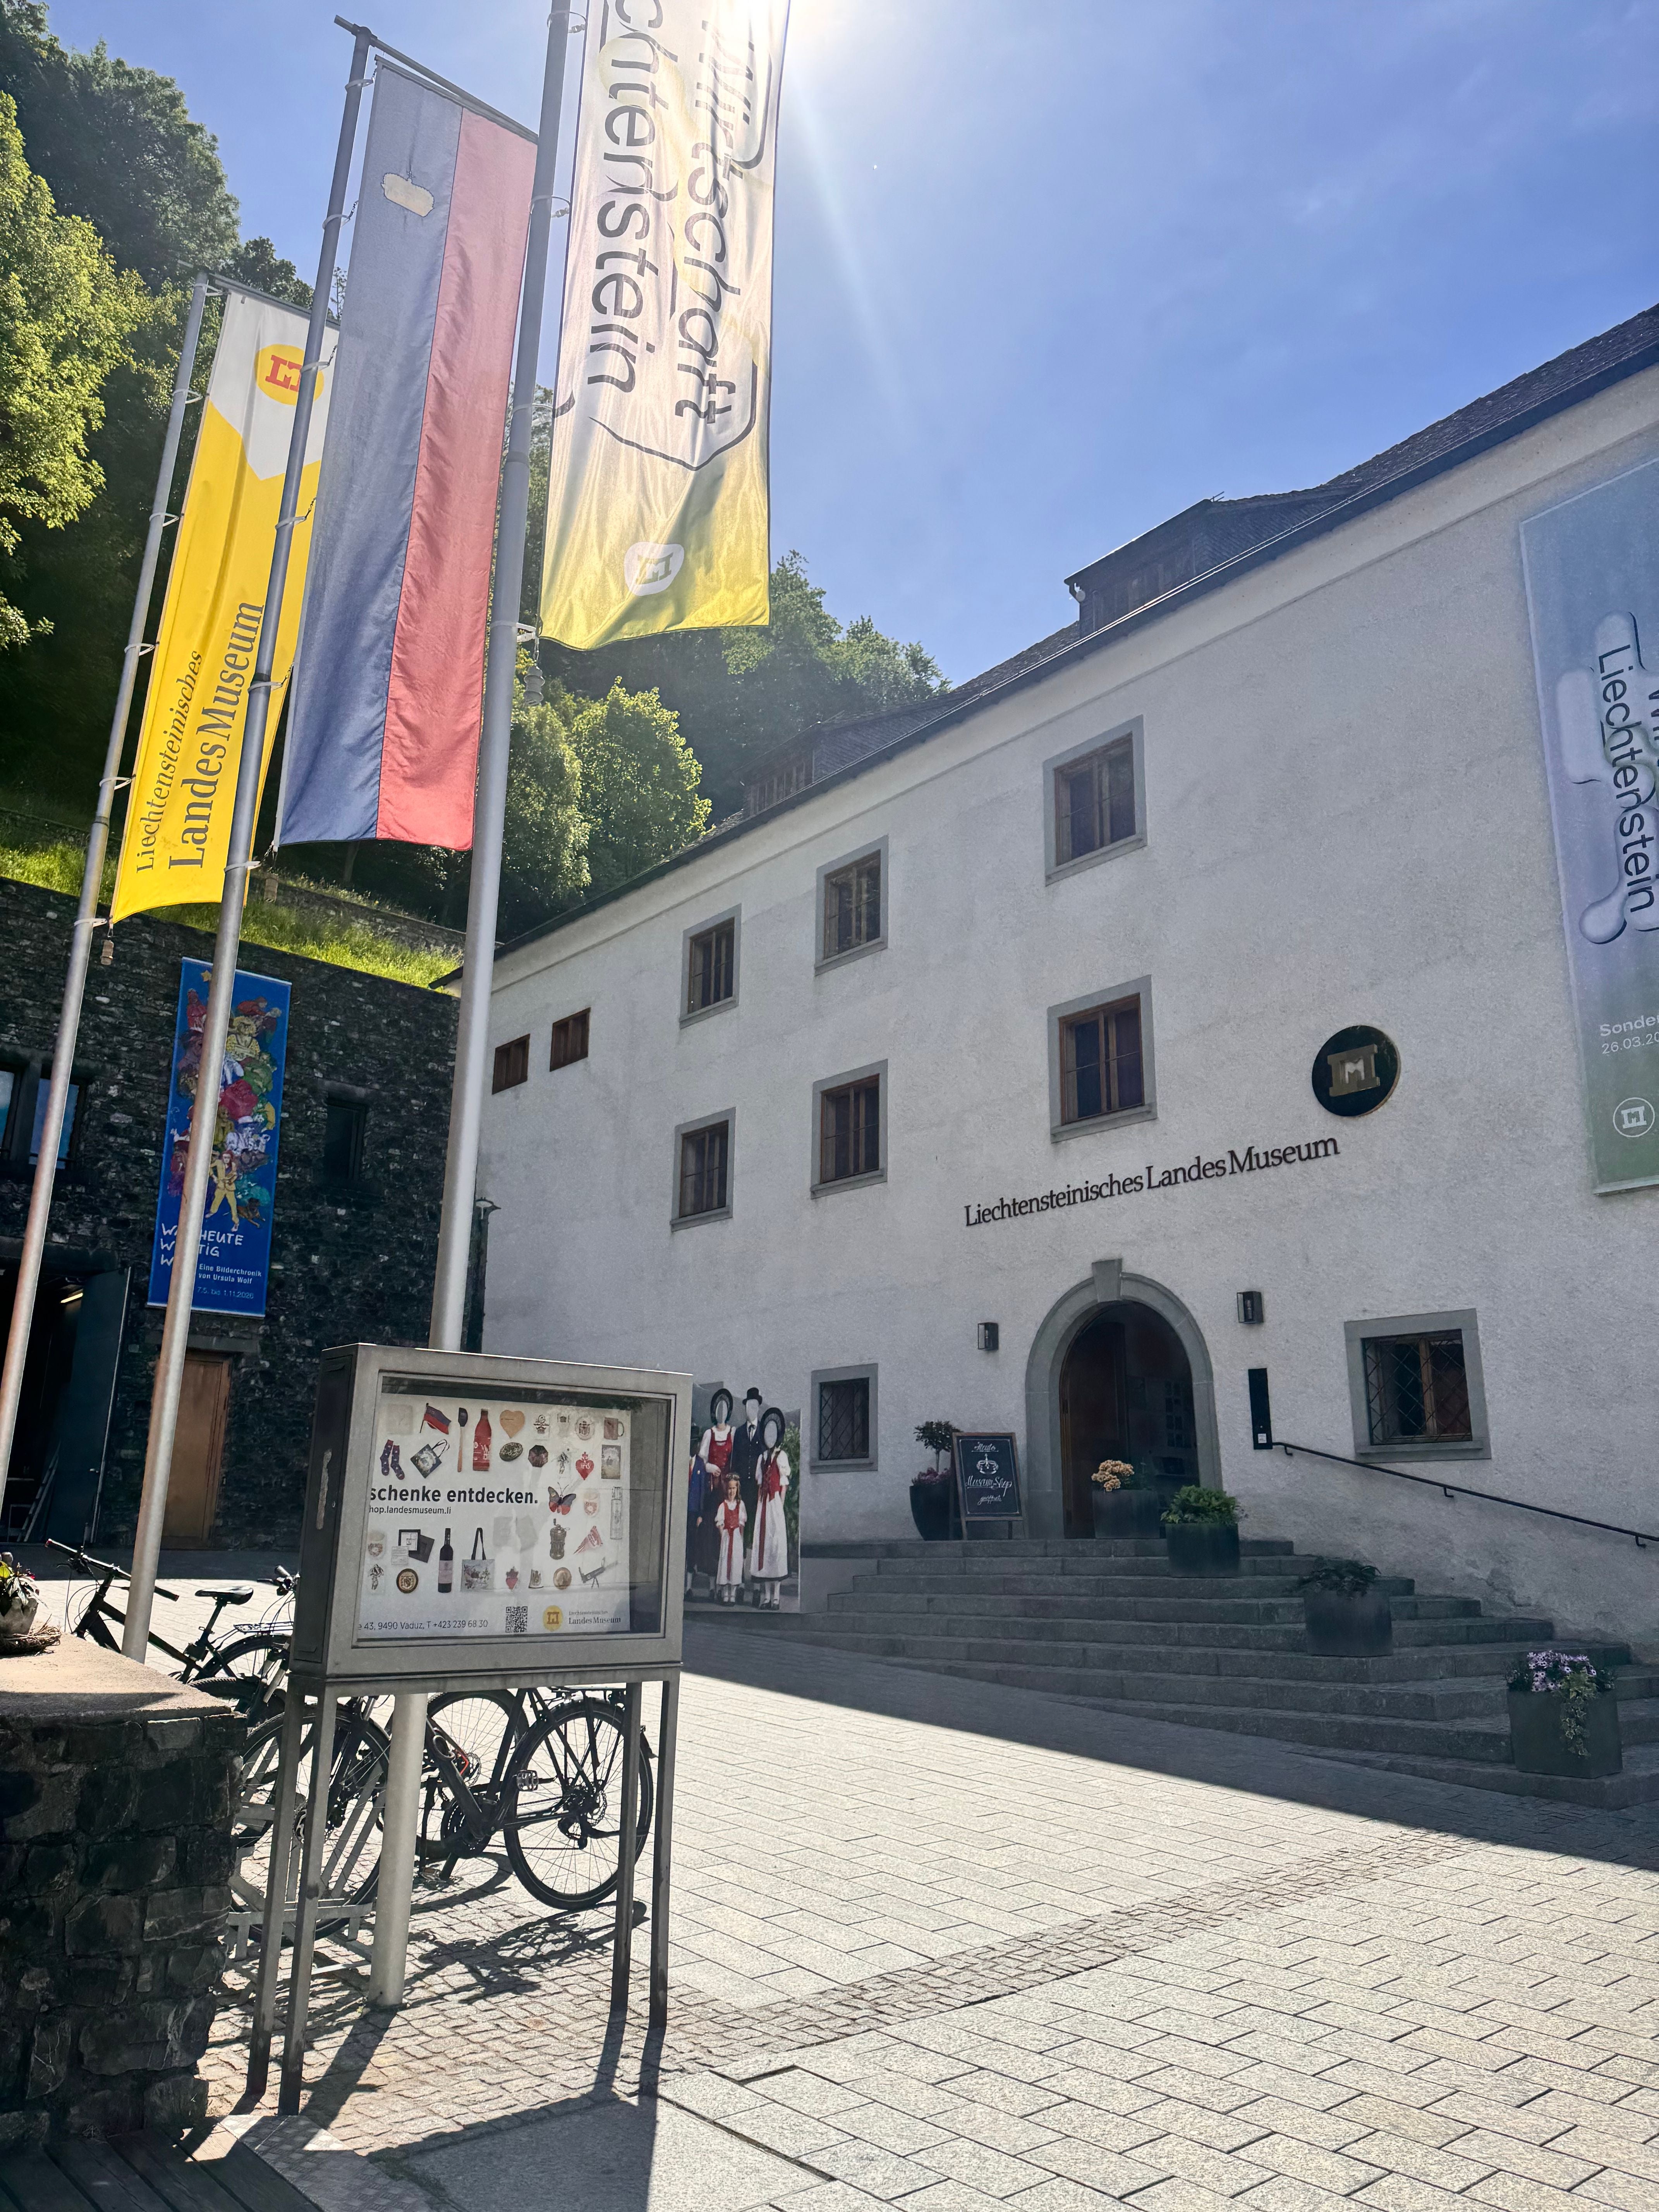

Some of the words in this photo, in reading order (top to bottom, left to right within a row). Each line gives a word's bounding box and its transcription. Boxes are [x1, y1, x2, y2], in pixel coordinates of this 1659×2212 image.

[136, 651, 202, 874] Liechtensteinisches
[1599, 644, 1659, 913] Liechtenstein
[964, 1173, 1144, 1226] Liechtensteinisches
[199, 1264, 213, 1272] Eine
[216, 1266, 262, 1277] Bilderchronik
[213, 1274, 234, 1282] Ursula
[447, 1487, 538, 1504] entdecken.
[400, 1622, 424, 1630] Vaduz,
